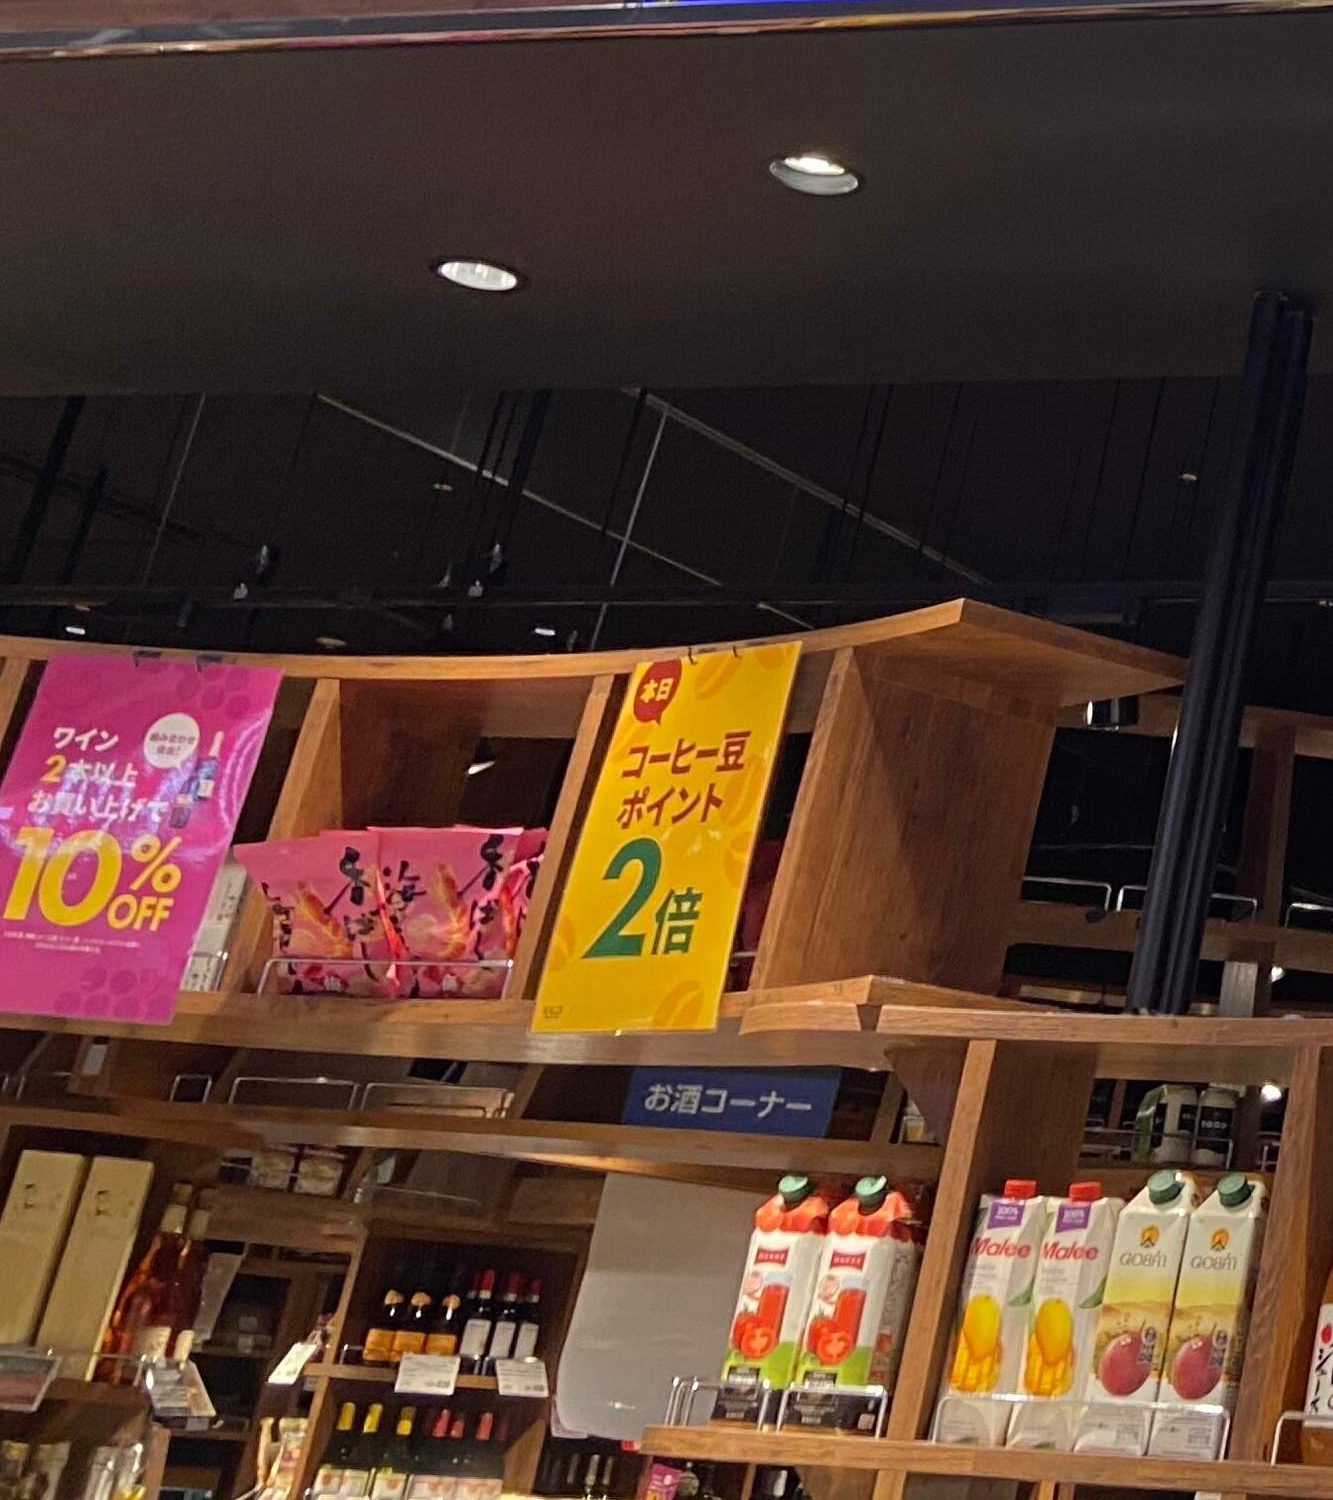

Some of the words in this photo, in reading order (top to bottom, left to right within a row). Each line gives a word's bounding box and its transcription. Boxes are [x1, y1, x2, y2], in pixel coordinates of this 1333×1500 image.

[640, 678, 674, 703] 本日
[54, 727, 119, 751] ワイン
[621, 730, 752, 779] コーヒー豆
[40, 754, 138, 788] 2本以上
[617, 782, 723, 829] ポイント
[3, 826, 182, 927] 10%
[107, 894, 174, 931] OFF
[644, 1083, 812, 1118] お酒コーナー
